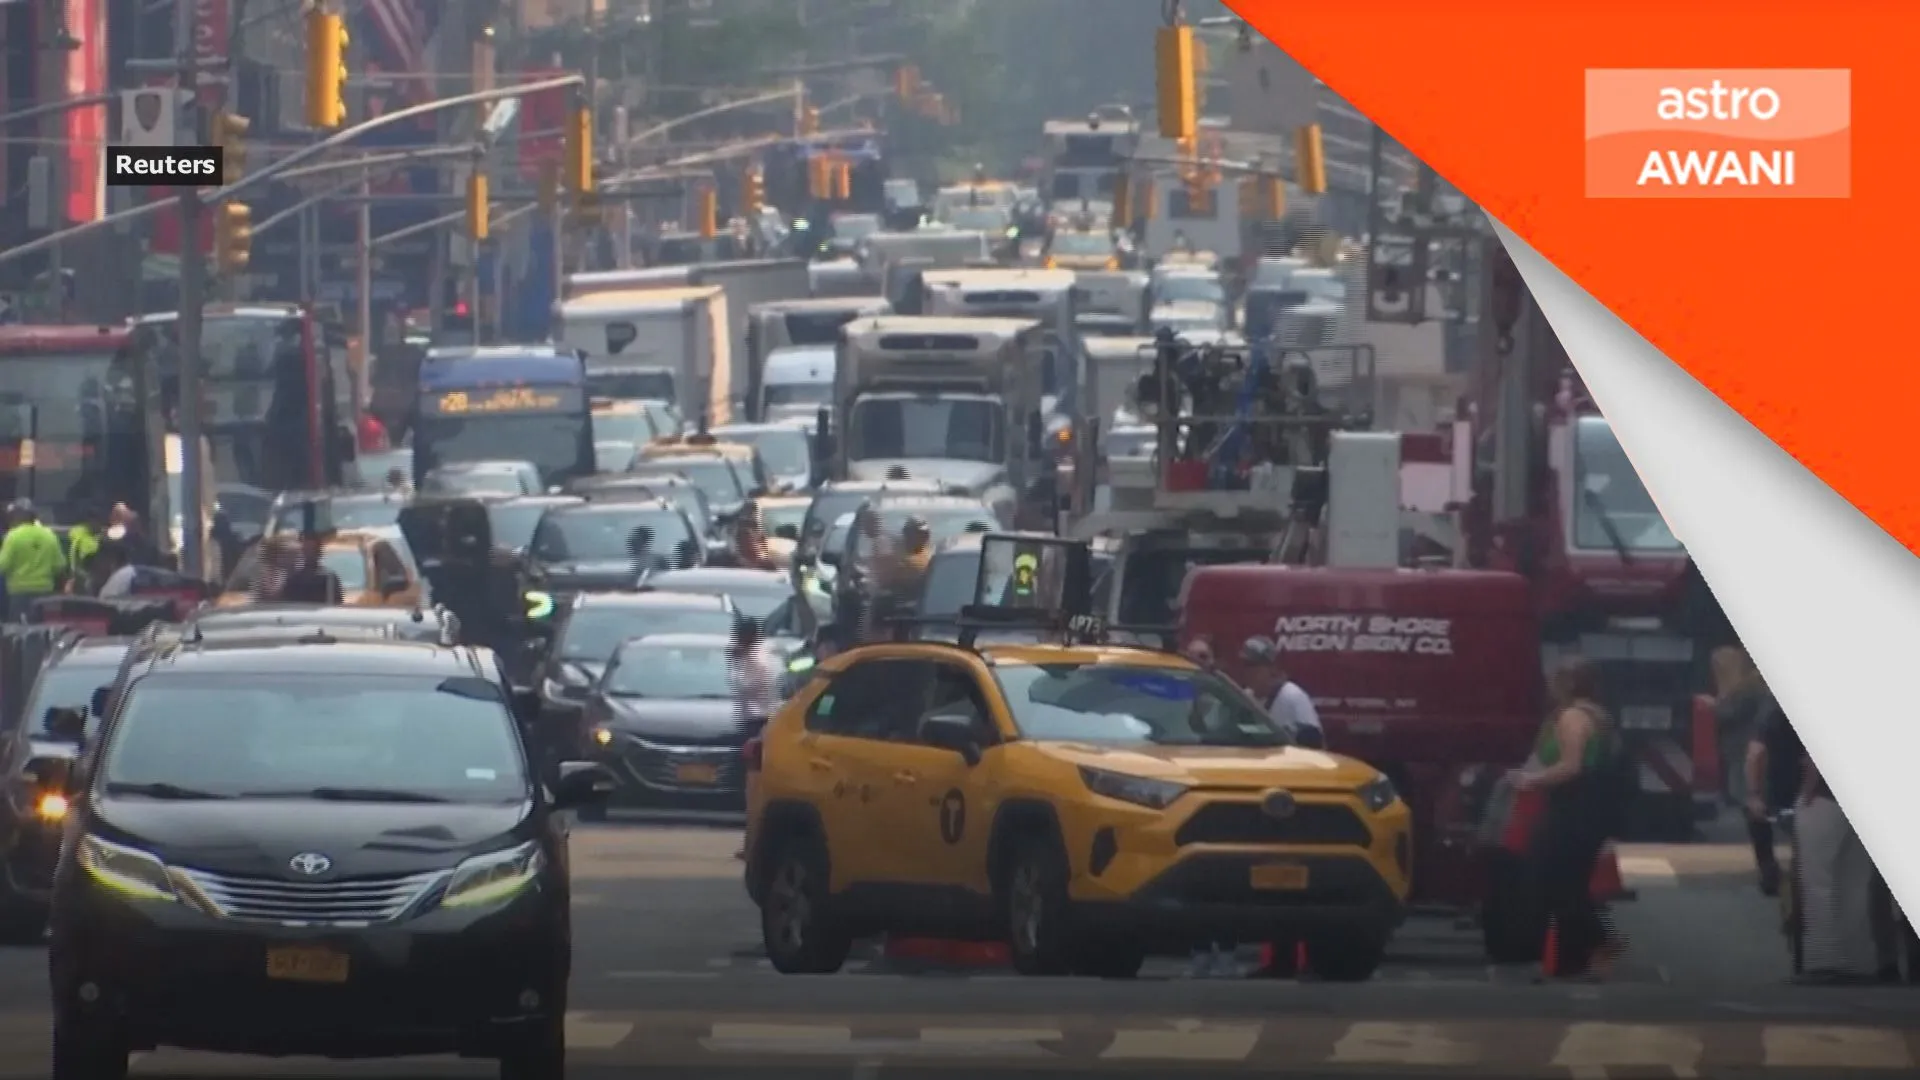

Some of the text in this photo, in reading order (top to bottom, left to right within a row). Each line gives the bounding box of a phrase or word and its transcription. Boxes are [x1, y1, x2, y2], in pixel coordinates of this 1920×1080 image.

[1275, 616, 1452, 635] NORTH SHORE
[1276, 634, 1454, 655] NEON SIGN CO.
